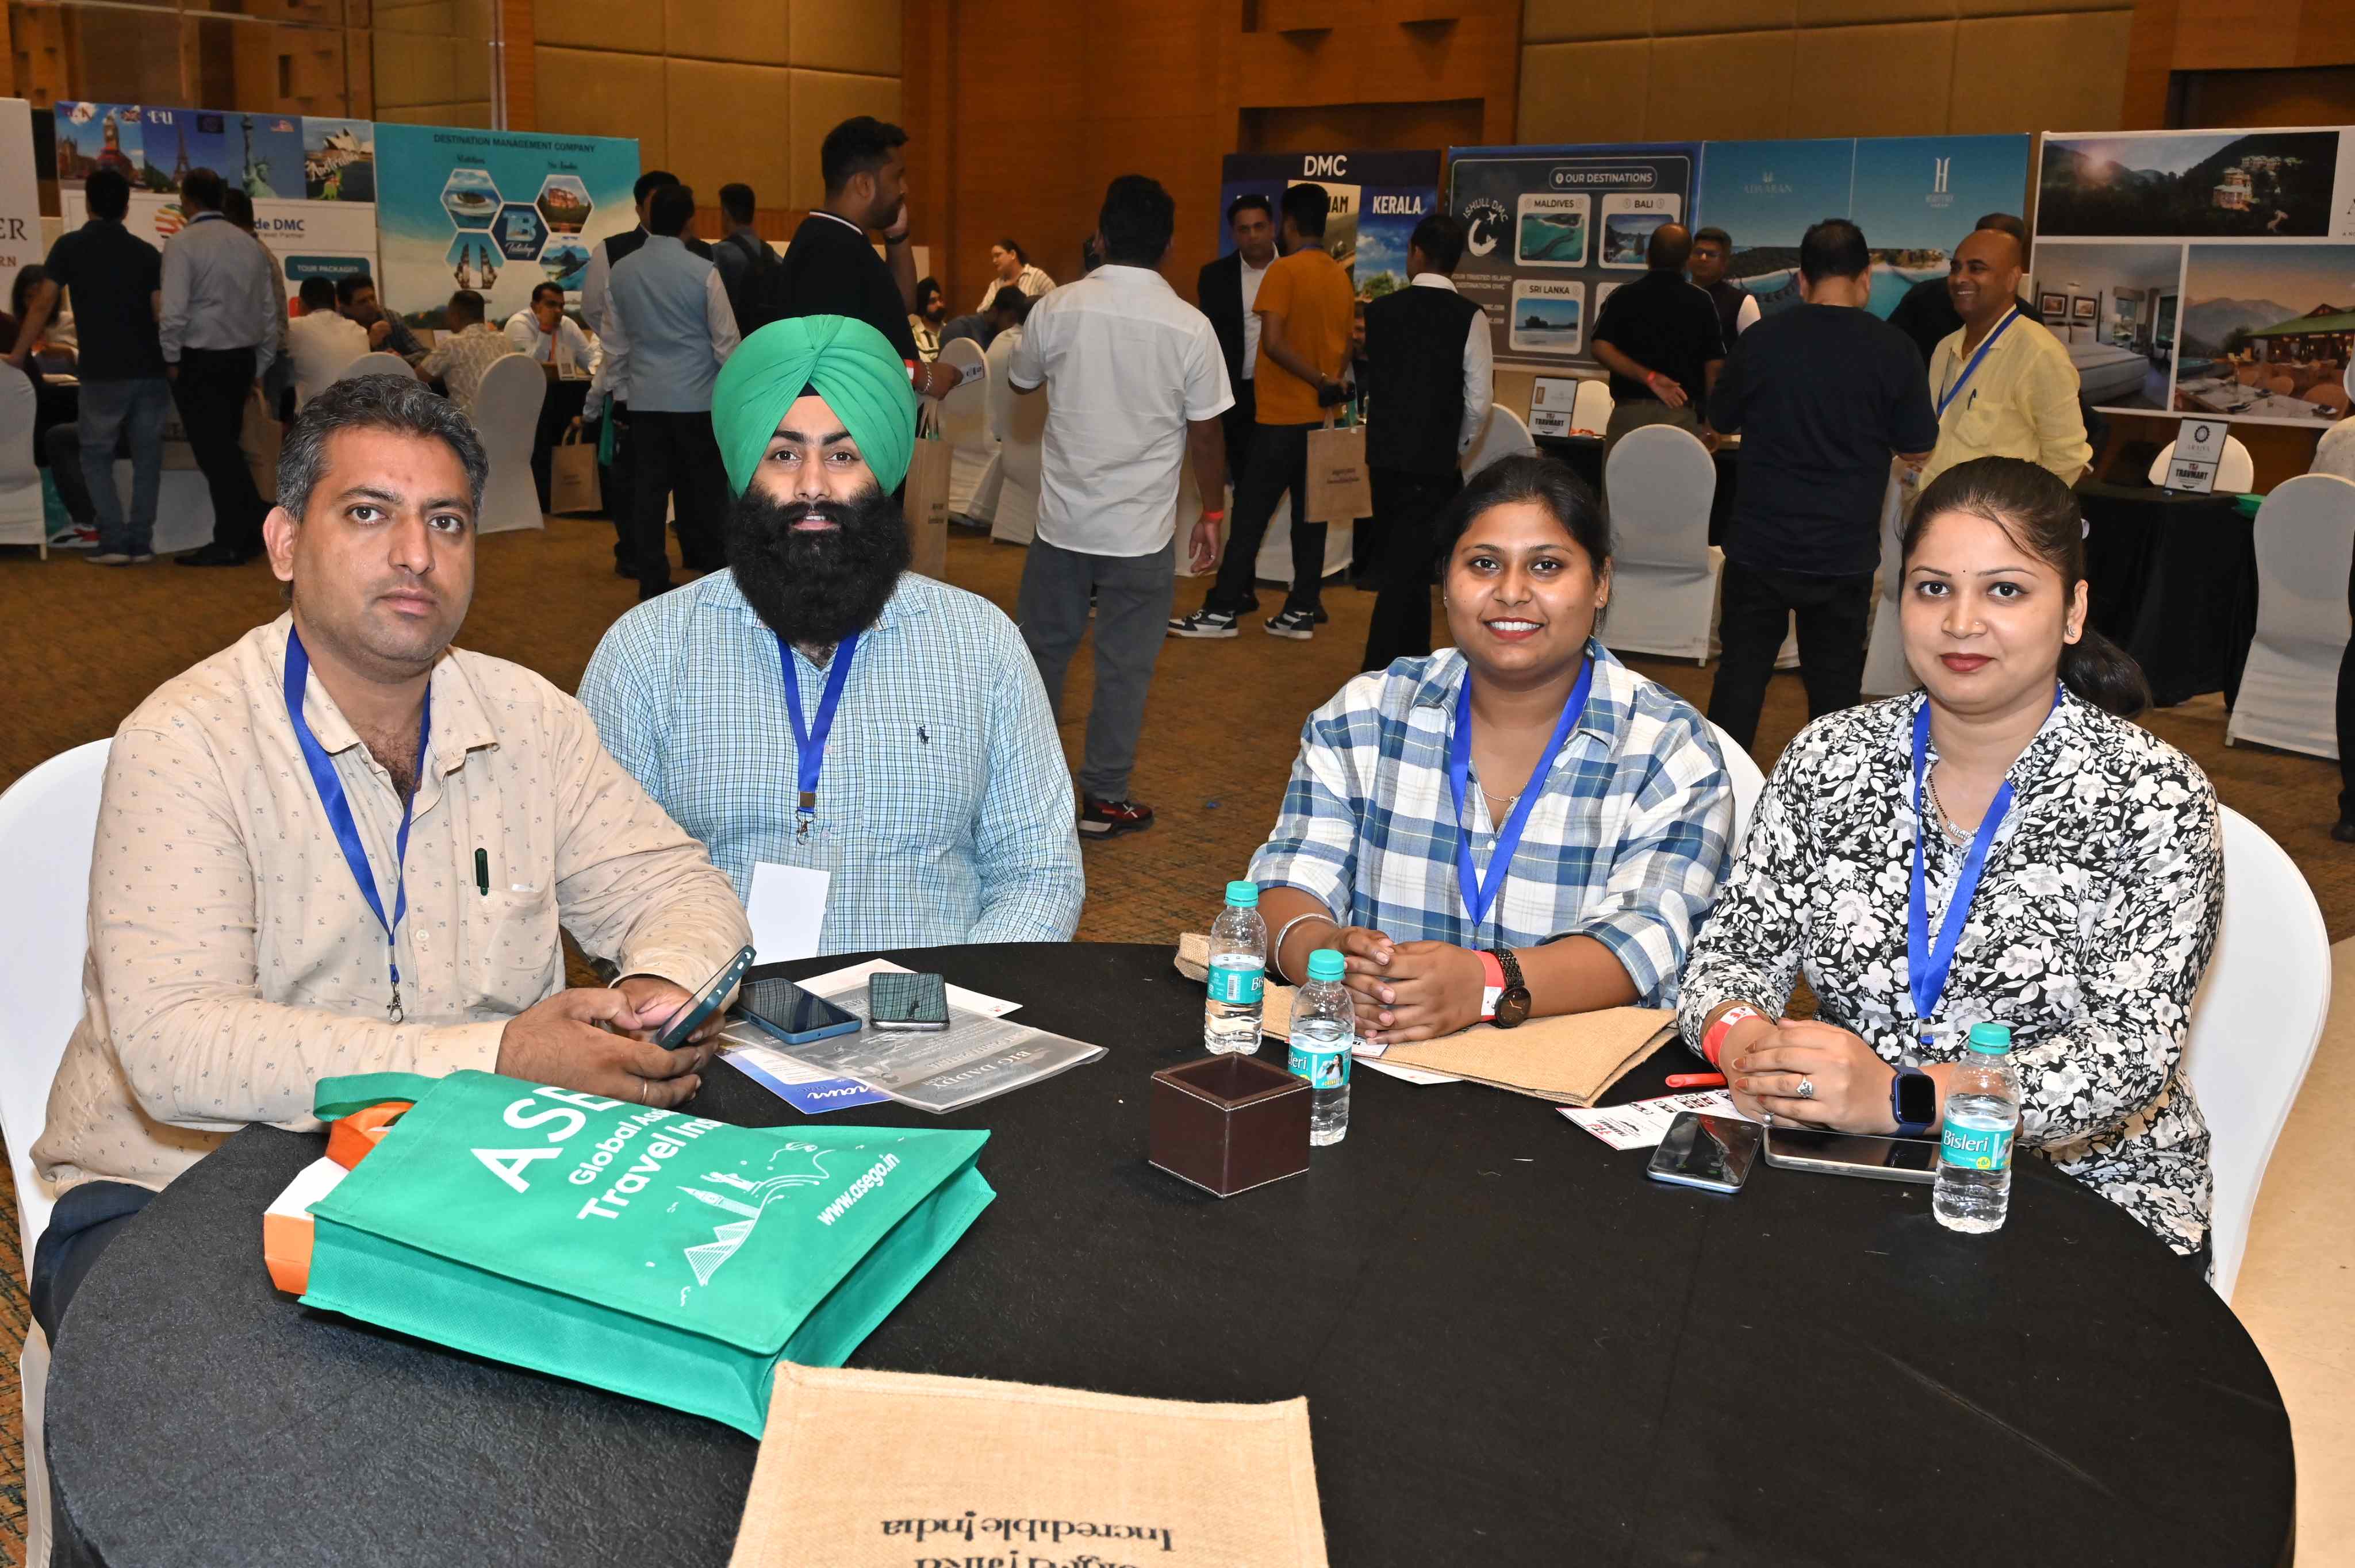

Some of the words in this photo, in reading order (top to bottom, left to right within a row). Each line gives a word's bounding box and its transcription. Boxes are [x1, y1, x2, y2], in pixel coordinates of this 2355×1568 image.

[434, 134, 489, 146] DESTINATION
[492, 139, 553, 151] MANAGEMENT
[554, 141, 596, 153] COMPANY
[1303, 155, 1348, 176] DMC
[1565, 174, 1585, 183] OUR
[1586, 172, 1653, 183] DESTINATIONS
[1372, 195, 1422, 214] KERALA
[1462, 197, 1490, 220] ISHULL
[1491, 199, 1509, 223] DMC
[1533, 199, 1575, 209] MALDIVES
[1634, 199, 1654, 209] BALI
[273, 219, 305, 231] DMC
[296, 264, 318, 272] TOUR
[319, 266, 360, 274] PACKAGES
[1529, 285, 1542, 294] SRI
[1543, 285, 1571, 295] LANKA
[2175, 468, 2208, 481] TRAVMART
[998, 1050, 1031, 1064] BIG
[933, 1063, 996, 1090] DADDY
[1943, 1129, 1989, 1152] Bisleri
[568, 1121, 642, 1185] Global
[576, 1132, 687, 1220] Travel
[816, 1152, 900, 1226] www.asego.in
[980, 1517, 1176, 1551] Incredible
